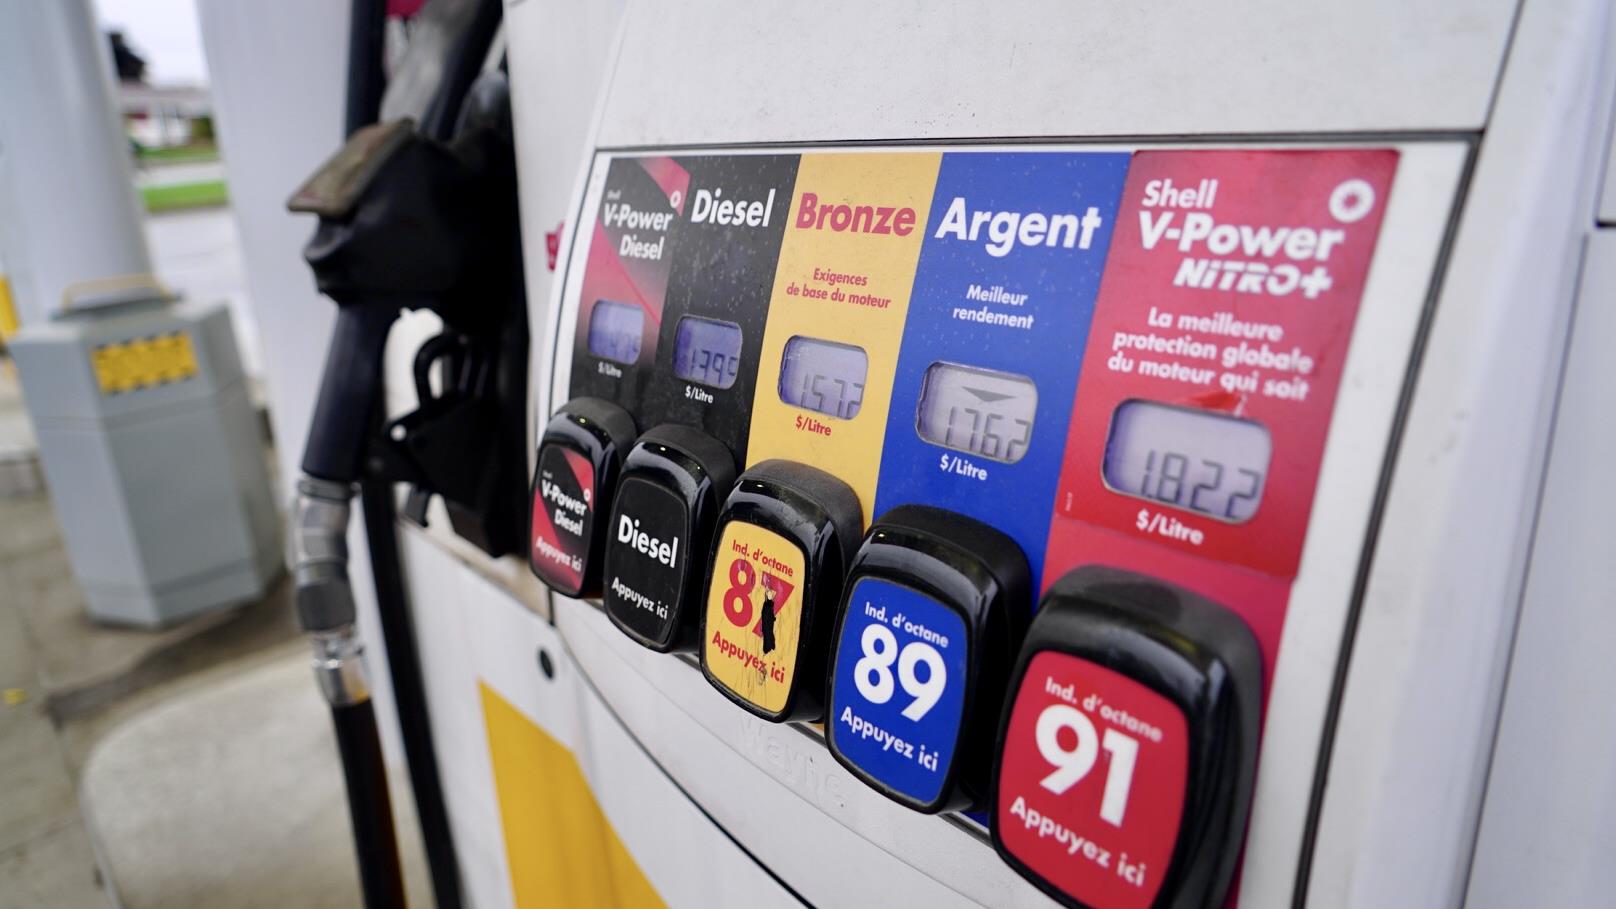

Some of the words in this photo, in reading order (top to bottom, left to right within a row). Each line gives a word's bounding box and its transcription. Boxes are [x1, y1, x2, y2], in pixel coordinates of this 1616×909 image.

[690, 187, 776, 228] Diesel
[1141, 178, 1218, 208] Shell
[603, 203, 673, 231] V-Power
[795, 192, 917, 237] Bronze
[935, 197, 1102, 257] Argent
[619, 234, 665, 260] Diesel
[1138, 211, 1345, 262] V-Power
[786, 282, 800, 297] de
[802, 284, 828, 301] base
[831, 287, 846, 303] du
[848, 292, 892, 309] moteur
[813, 268, 868, 287] Exigences
[966, 284, 1028, 307] Meilleur
[953, 307, 1034, 330] rendement
[1148, 307, 1173, 328] La
[1178, 313, 1284, 342] meilleure
[598, 361, 623, 378] $/Litre
[1113, 332, 1217, 360] protection
[1222, 345, 1314, 374] globale
[685, 385, 714, 404] $/Litre
[1108, 351, 1134, 373] du
[1139, 361, 1214, 386] moteur
[1221, 371, 1258, 394] qui
[1265, 375, 1309, 401] soit
[795, 415, 832, 436] $/Litre
[940, 454, 988, 481] $/Litre
[542, 479, 588, 516] V-Power
[554, 508, 583, 536] Diesel
[618, 514, 679, 568] Diesel
[1136, 509, 1204, 545] $/Litre
[536, 535, 571, 566] Appuyez
[572, 555, 582, 572] ici
[732, 539, 750, 558] Ind.
[752, 547, 794, 578] d'octane
[611, 577, 654, 612] Appuyez
[656, 600, 668, 619] ici
[723, 558, 795, 638] 87
[865, 602, 889, 624] Ind.
[892, 604, 949, 648] d'octane
[712, 631, 767, 675] Appuyez
[770, 661, 786, 684] ici
[853, 623, 947, 722] 89
[1045, 677, 1077, 704] Ind.
[1083, 691, 1164, 743] d'octane
[840, 706, 913, 760] Appuyez
[917, 745, 939, 772] ici
[1035, 704, 1140, 828] 91
[1010, 797, 1111, 868] Appuyez
[1117, 853, 1146, 887] ici
